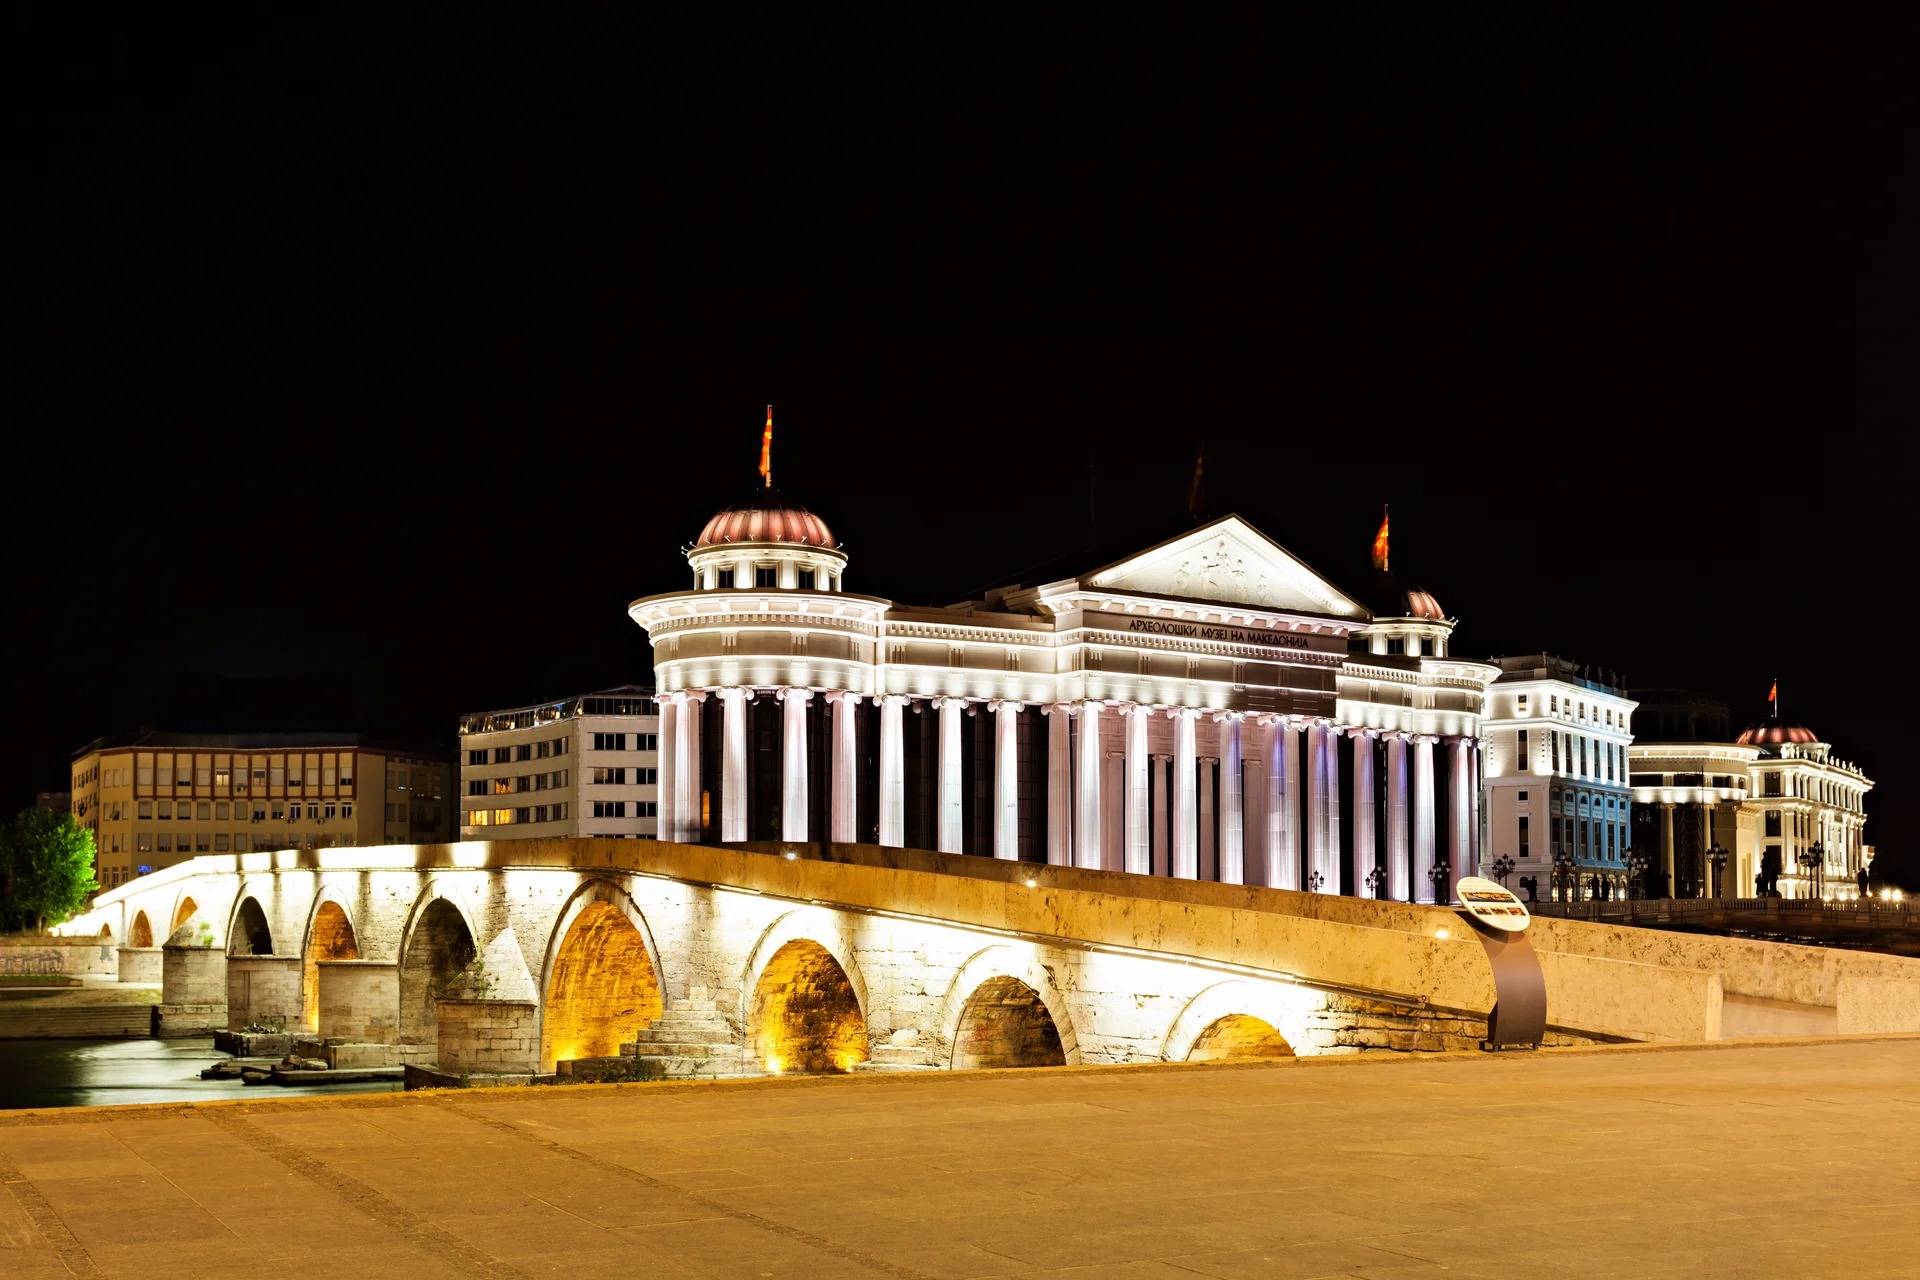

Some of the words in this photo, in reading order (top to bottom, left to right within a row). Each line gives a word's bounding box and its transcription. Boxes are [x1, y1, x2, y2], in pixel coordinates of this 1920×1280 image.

[1130, 620, 1196, 637] АРХЕОЛОШКИ
[1201, 627, 1227, 640] МУЗЕЈ
[1231, 631, 1244, 642] НА
[1248, 633, 1308, 648] МАКЕДОНИЈА
